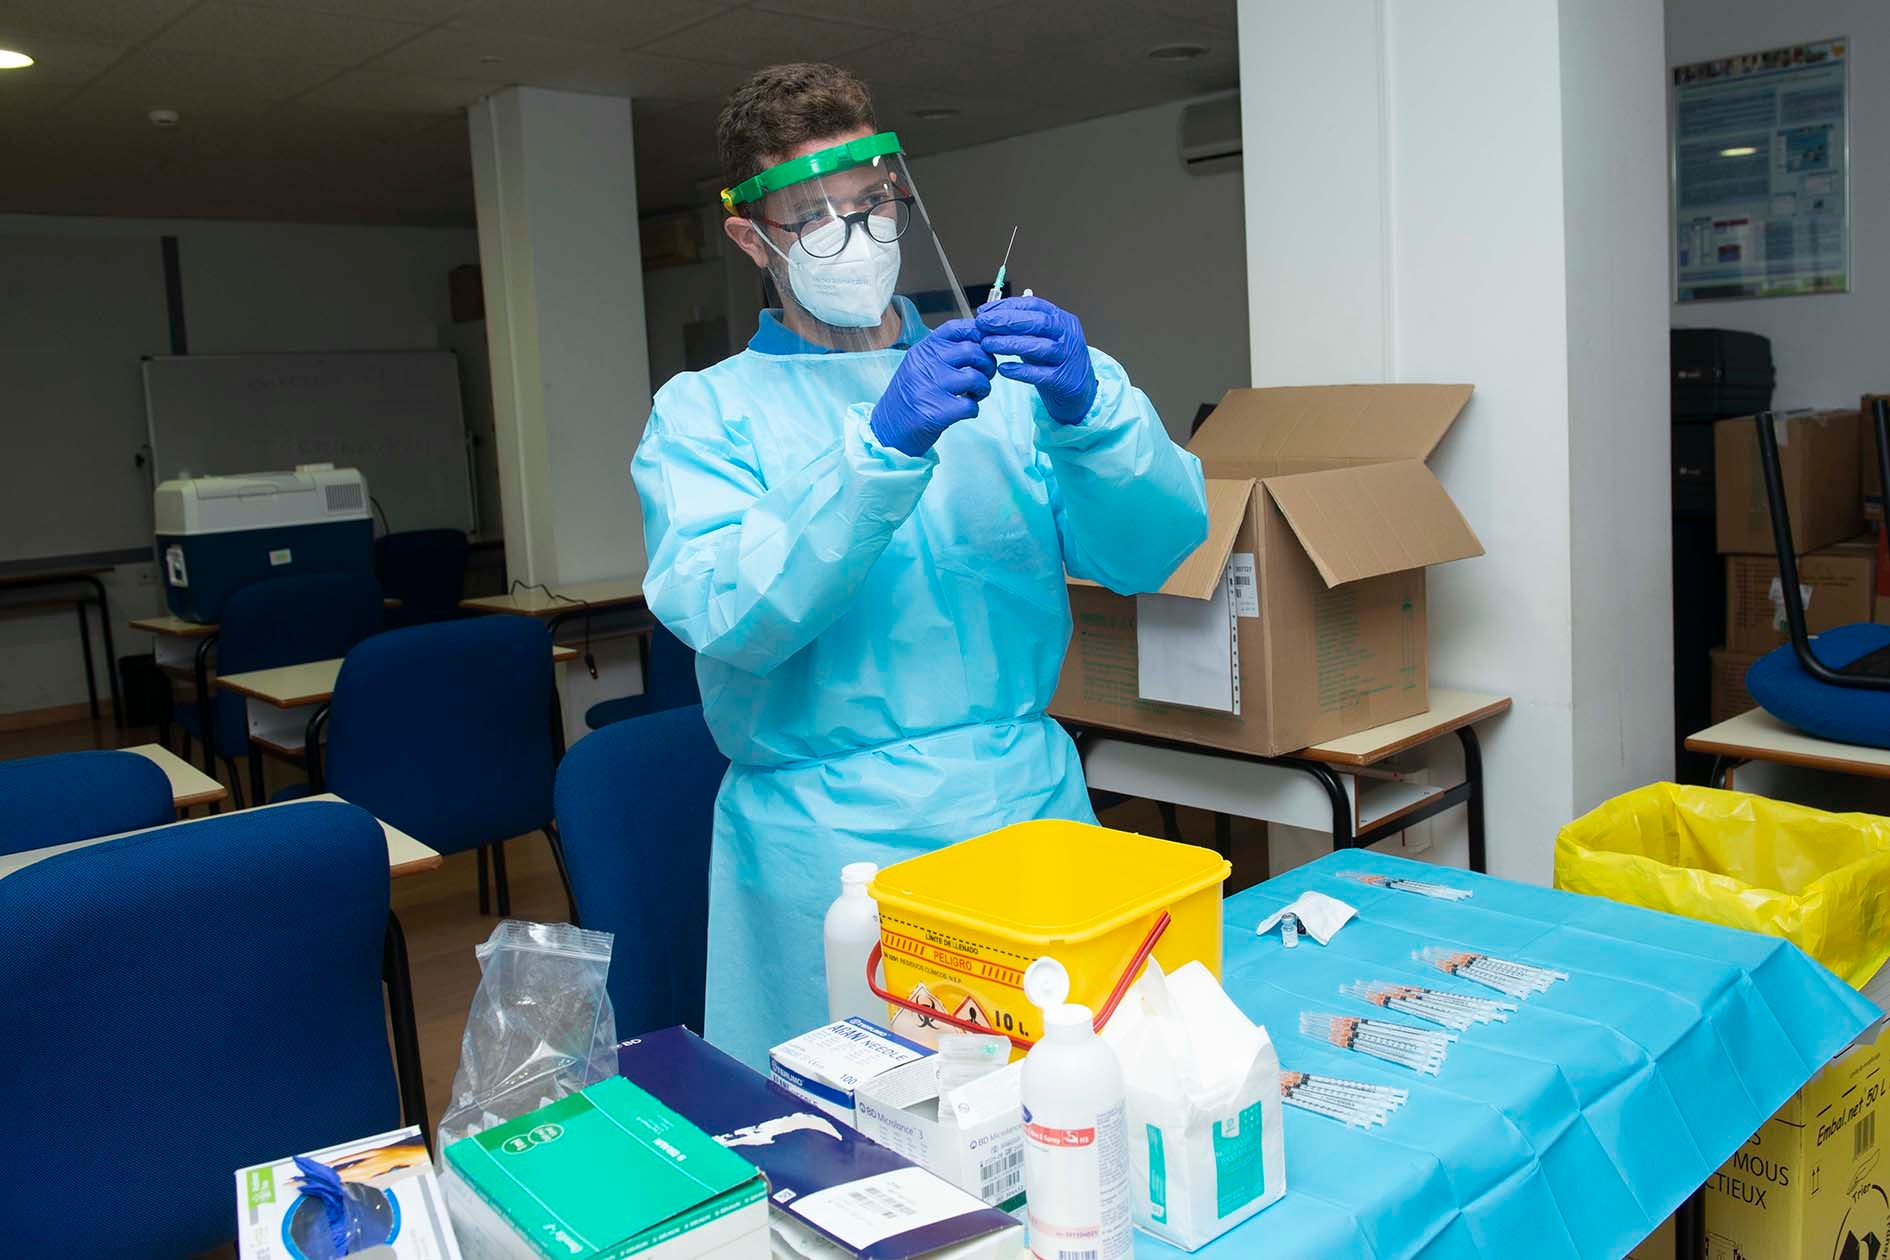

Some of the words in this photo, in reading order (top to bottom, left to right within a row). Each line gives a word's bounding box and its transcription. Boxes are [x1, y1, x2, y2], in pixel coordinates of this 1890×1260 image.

[933, 950, 972, 971] PELIGRO
[995, 1010, 1014, 1031] 10
[863, 1040, 909, 1062] NEEDLE
[839, 1073, 858, 1086] 100
[1866, 1083, 1879, 1108] 50
[1880, 1078, 1886, 1097] L
[978, 1135, 989, 1147] BD
[1733, 1150, 1789, 1187] MOUS
[1852, 1183, 1872, 1203] Trier
